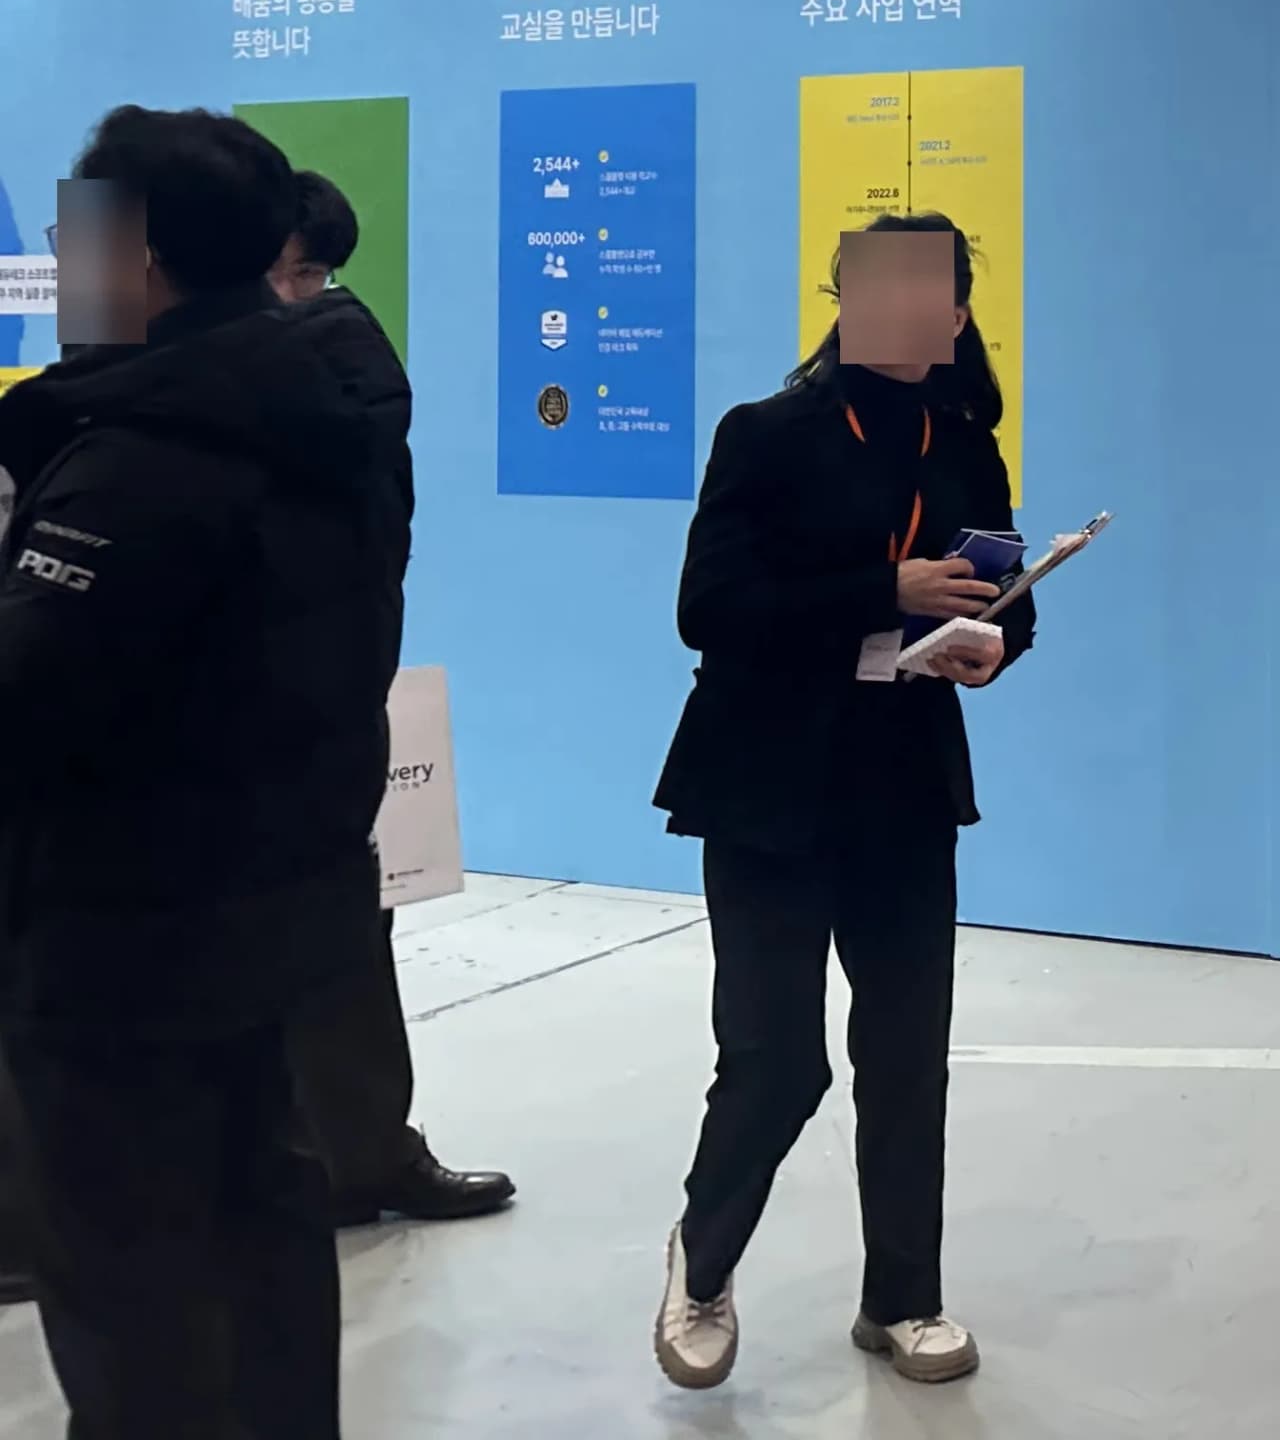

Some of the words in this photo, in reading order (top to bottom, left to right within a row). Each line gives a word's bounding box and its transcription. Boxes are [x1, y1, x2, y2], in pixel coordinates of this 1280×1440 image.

[500, 8, 565, 42] 교실을
[571, 2, 661, 40] 만듭니다
[232, 25, 312, 60] 뜻합니다
[532, 156, 581, 176] 2,544+
[527, 231, 586, 248] 600,000+
